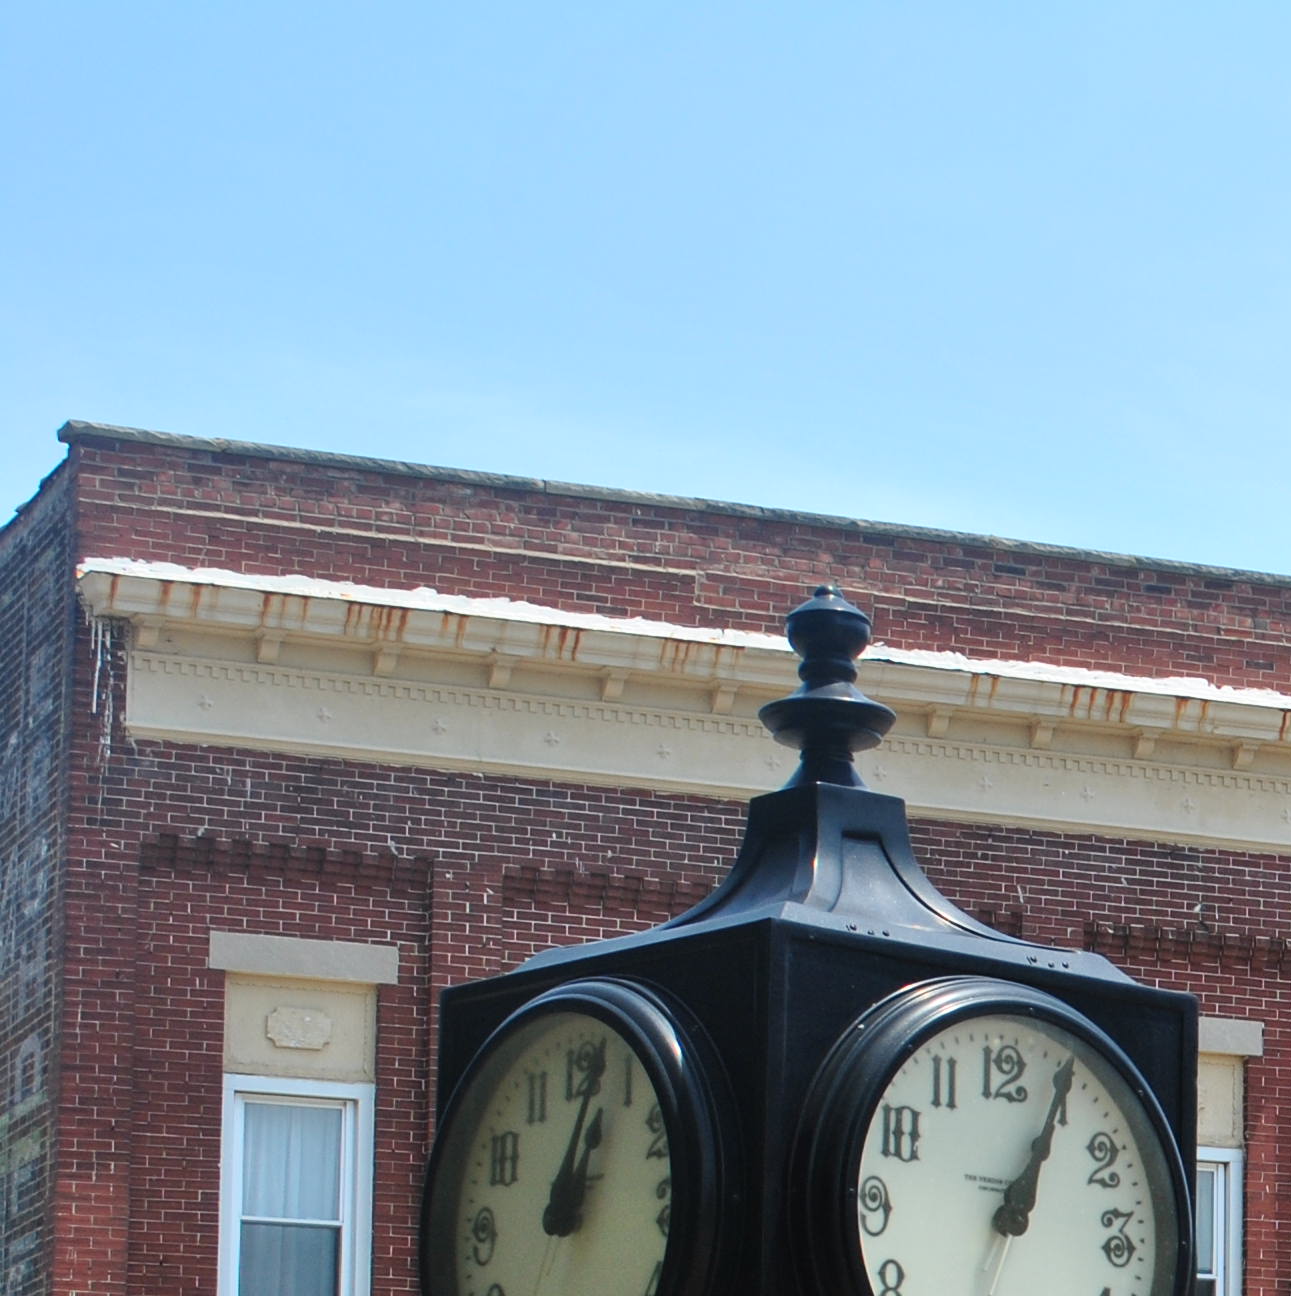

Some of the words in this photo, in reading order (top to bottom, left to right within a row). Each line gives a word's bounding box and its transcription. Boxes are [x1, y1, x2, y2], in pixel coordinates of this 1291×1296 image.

[526, 1071, 548, 1125] 11
[931, 1055, 957, 1109] 11
[981, 1045, 1028, 1103] 12
[881, 1104, 921, 1162] 10
[1086, 1132, 1121, 1188] 2
[860, 1175, 892, 1236] 9
[473, 1207, 498, 1266] 9
[1101, 1208, 1135, 1267] 3
